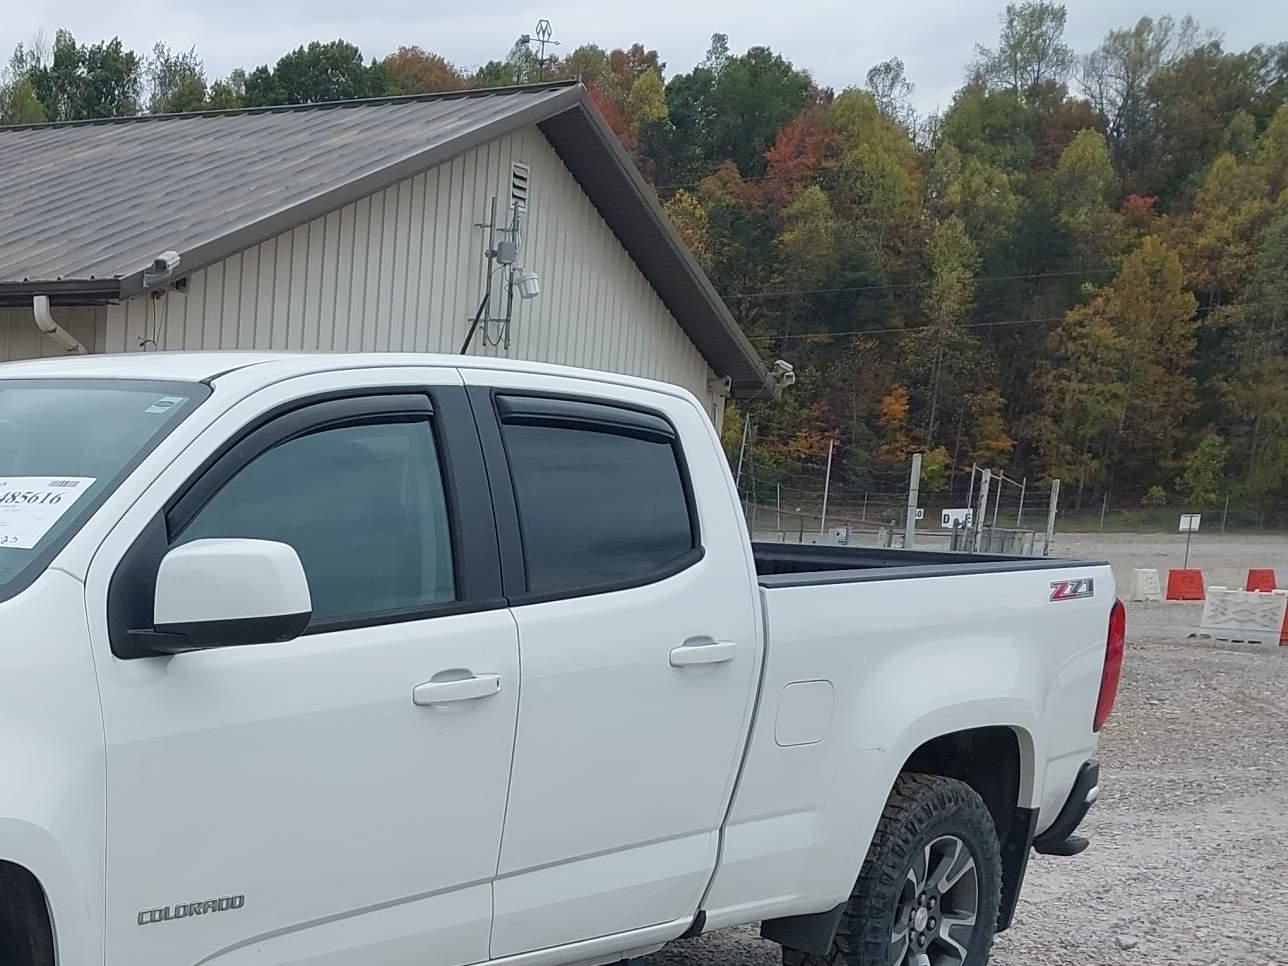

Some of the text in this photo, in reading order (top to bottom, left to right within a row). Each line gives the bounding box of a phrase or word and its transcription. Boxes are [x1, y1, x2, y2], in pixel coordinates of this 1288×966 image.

[943, 513, 950, 524] D
[1049, 577, 1095, 602] Z71
[137, 895, 245, 925] COLORADO
